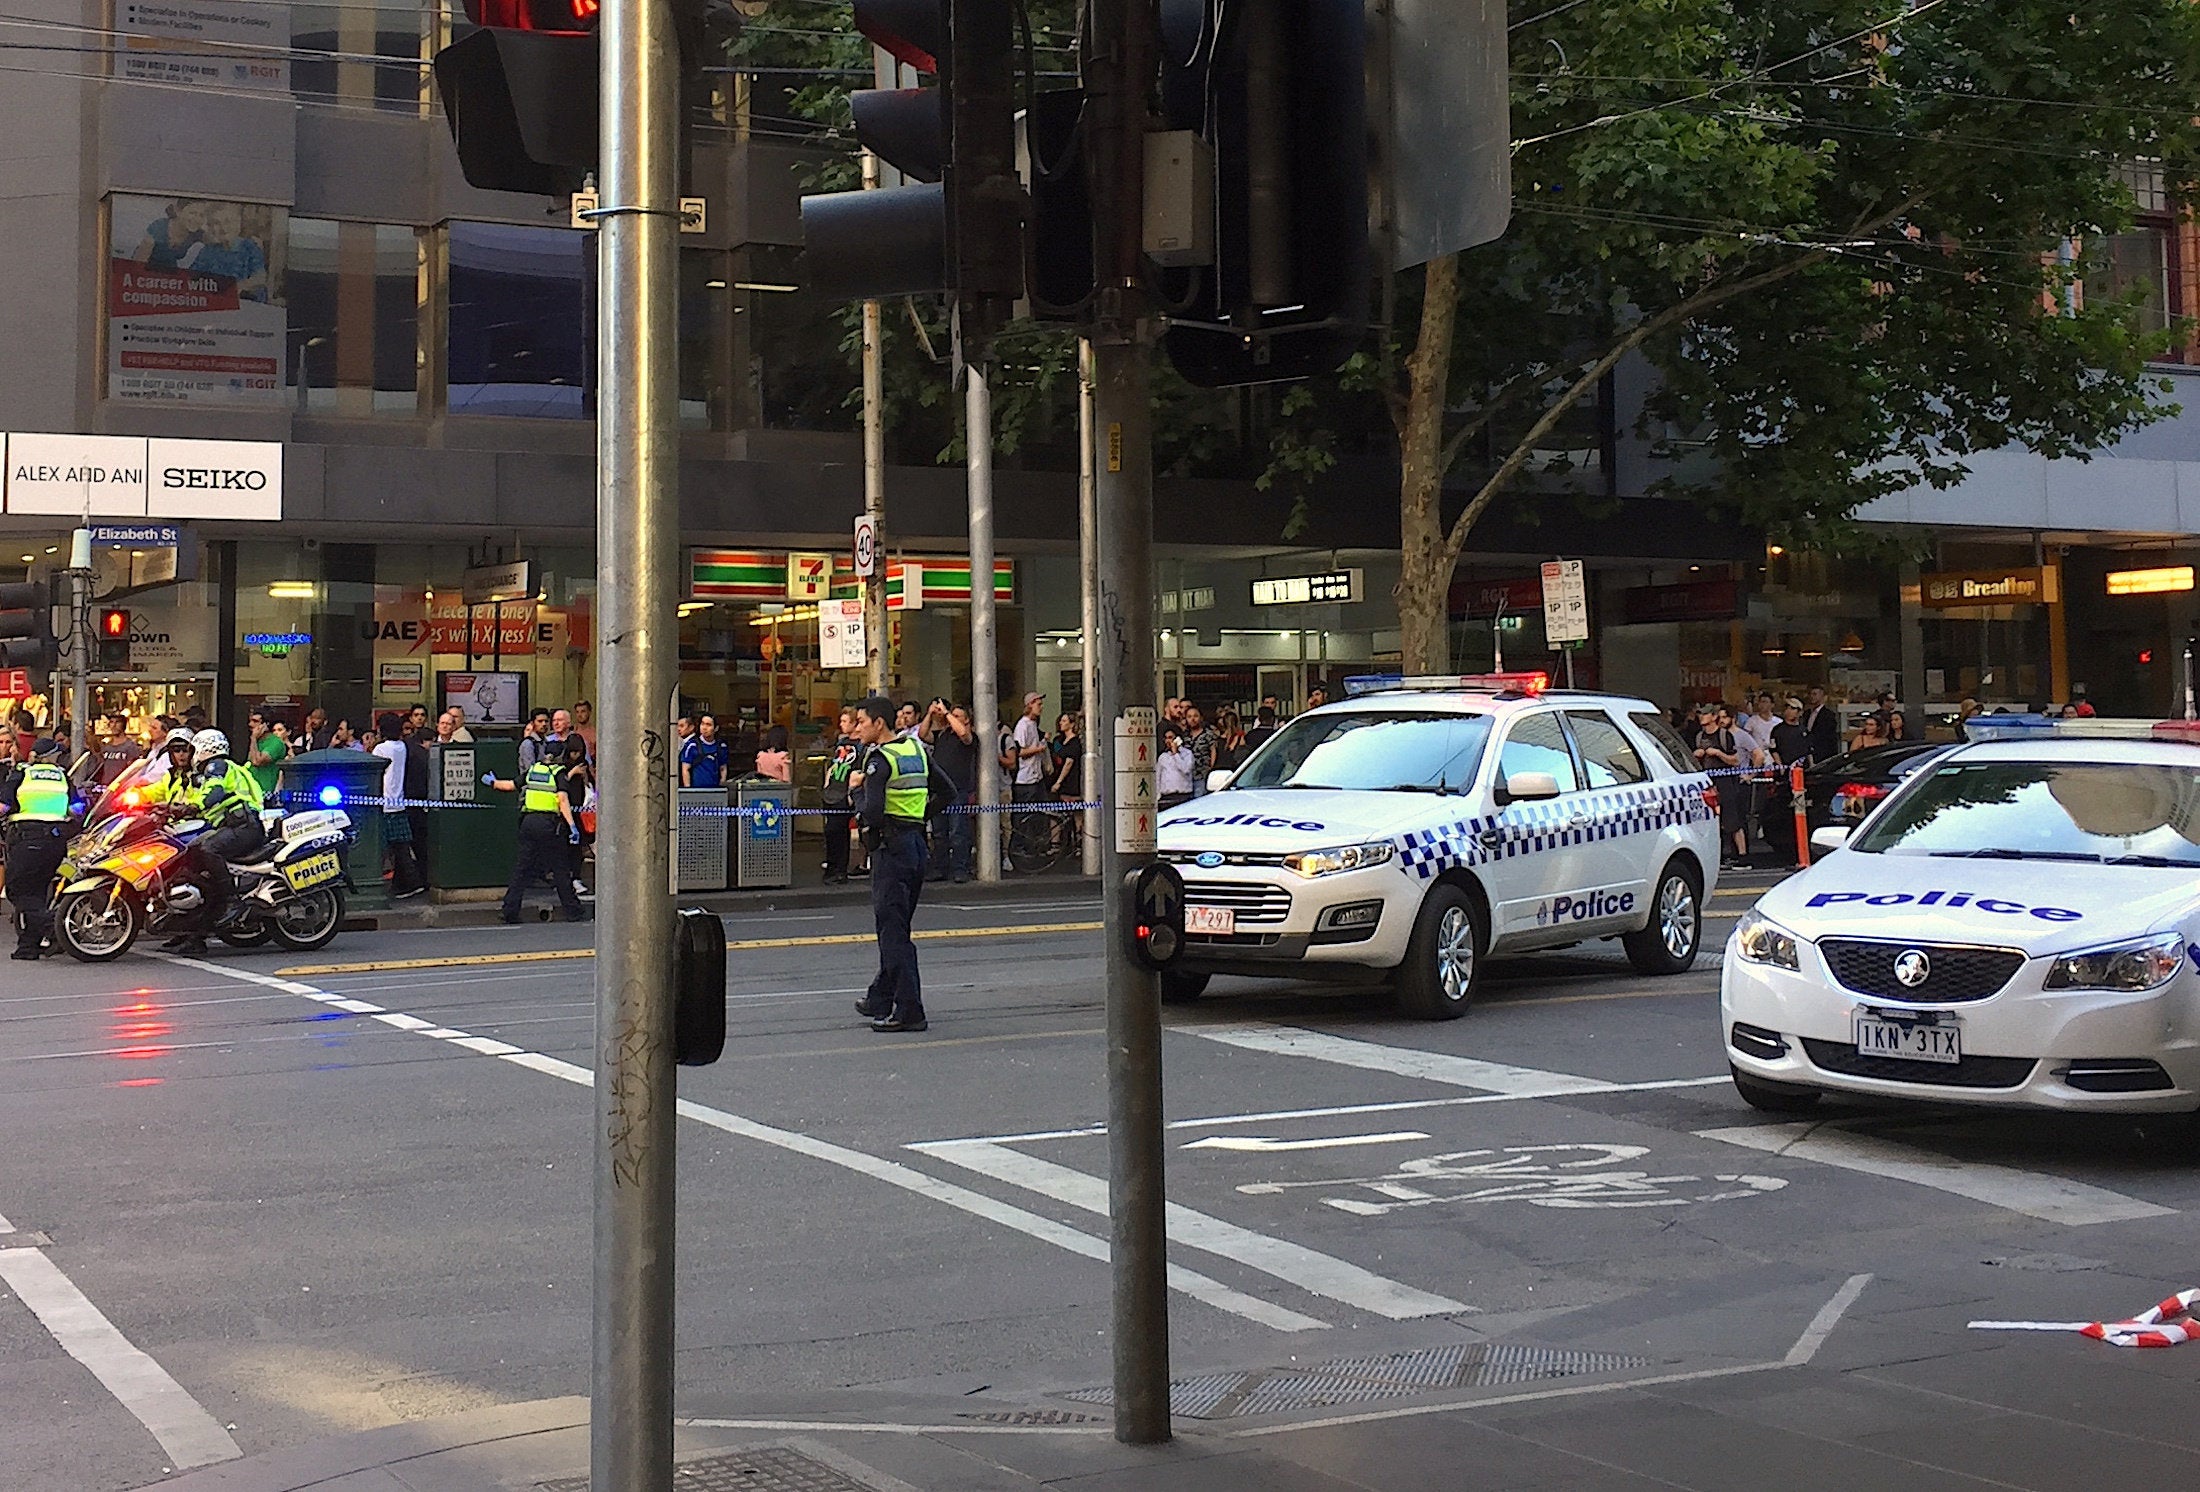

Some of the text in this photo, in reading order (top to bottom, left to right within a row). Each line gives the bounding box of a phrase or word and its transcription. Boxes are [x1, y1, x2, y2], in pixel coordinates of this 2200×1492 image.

[250, 65, 281, 79] RGIT
[122, 273, 218, 293] A career with
[122, 291, 208, 307] compassion
[245, 379, 277, 389] RGIT
[15, 465, 60, 482] ALEX
[111, 468, 142, 484] ANI
[163, 468, 267, 491] SEIKO
[98, 528, 177, 541] Elizabeth St
[858, 534, 872, 556] 40
[800, 558, 824, 594] 7
[1963, 576, 2036, 597] Breadtop
[486, 604, 534, 626] money
[1548, 602, 1561, 613] 1P
[1569, 601, 1582, 612] 1P
[129, 632, 170, 643] own
[847, 624, 860, 635] 1P
[1157, 813, 1325, 832] Police
[293, 859, 336, 882] POLICE
[1552, 890, 1634, 924] Police
[1804, 890, 2084, 922] Police
[1208, 911, 1231, 928] 297
[1864, 1025, 1955, 1055] 1KN 3TX
